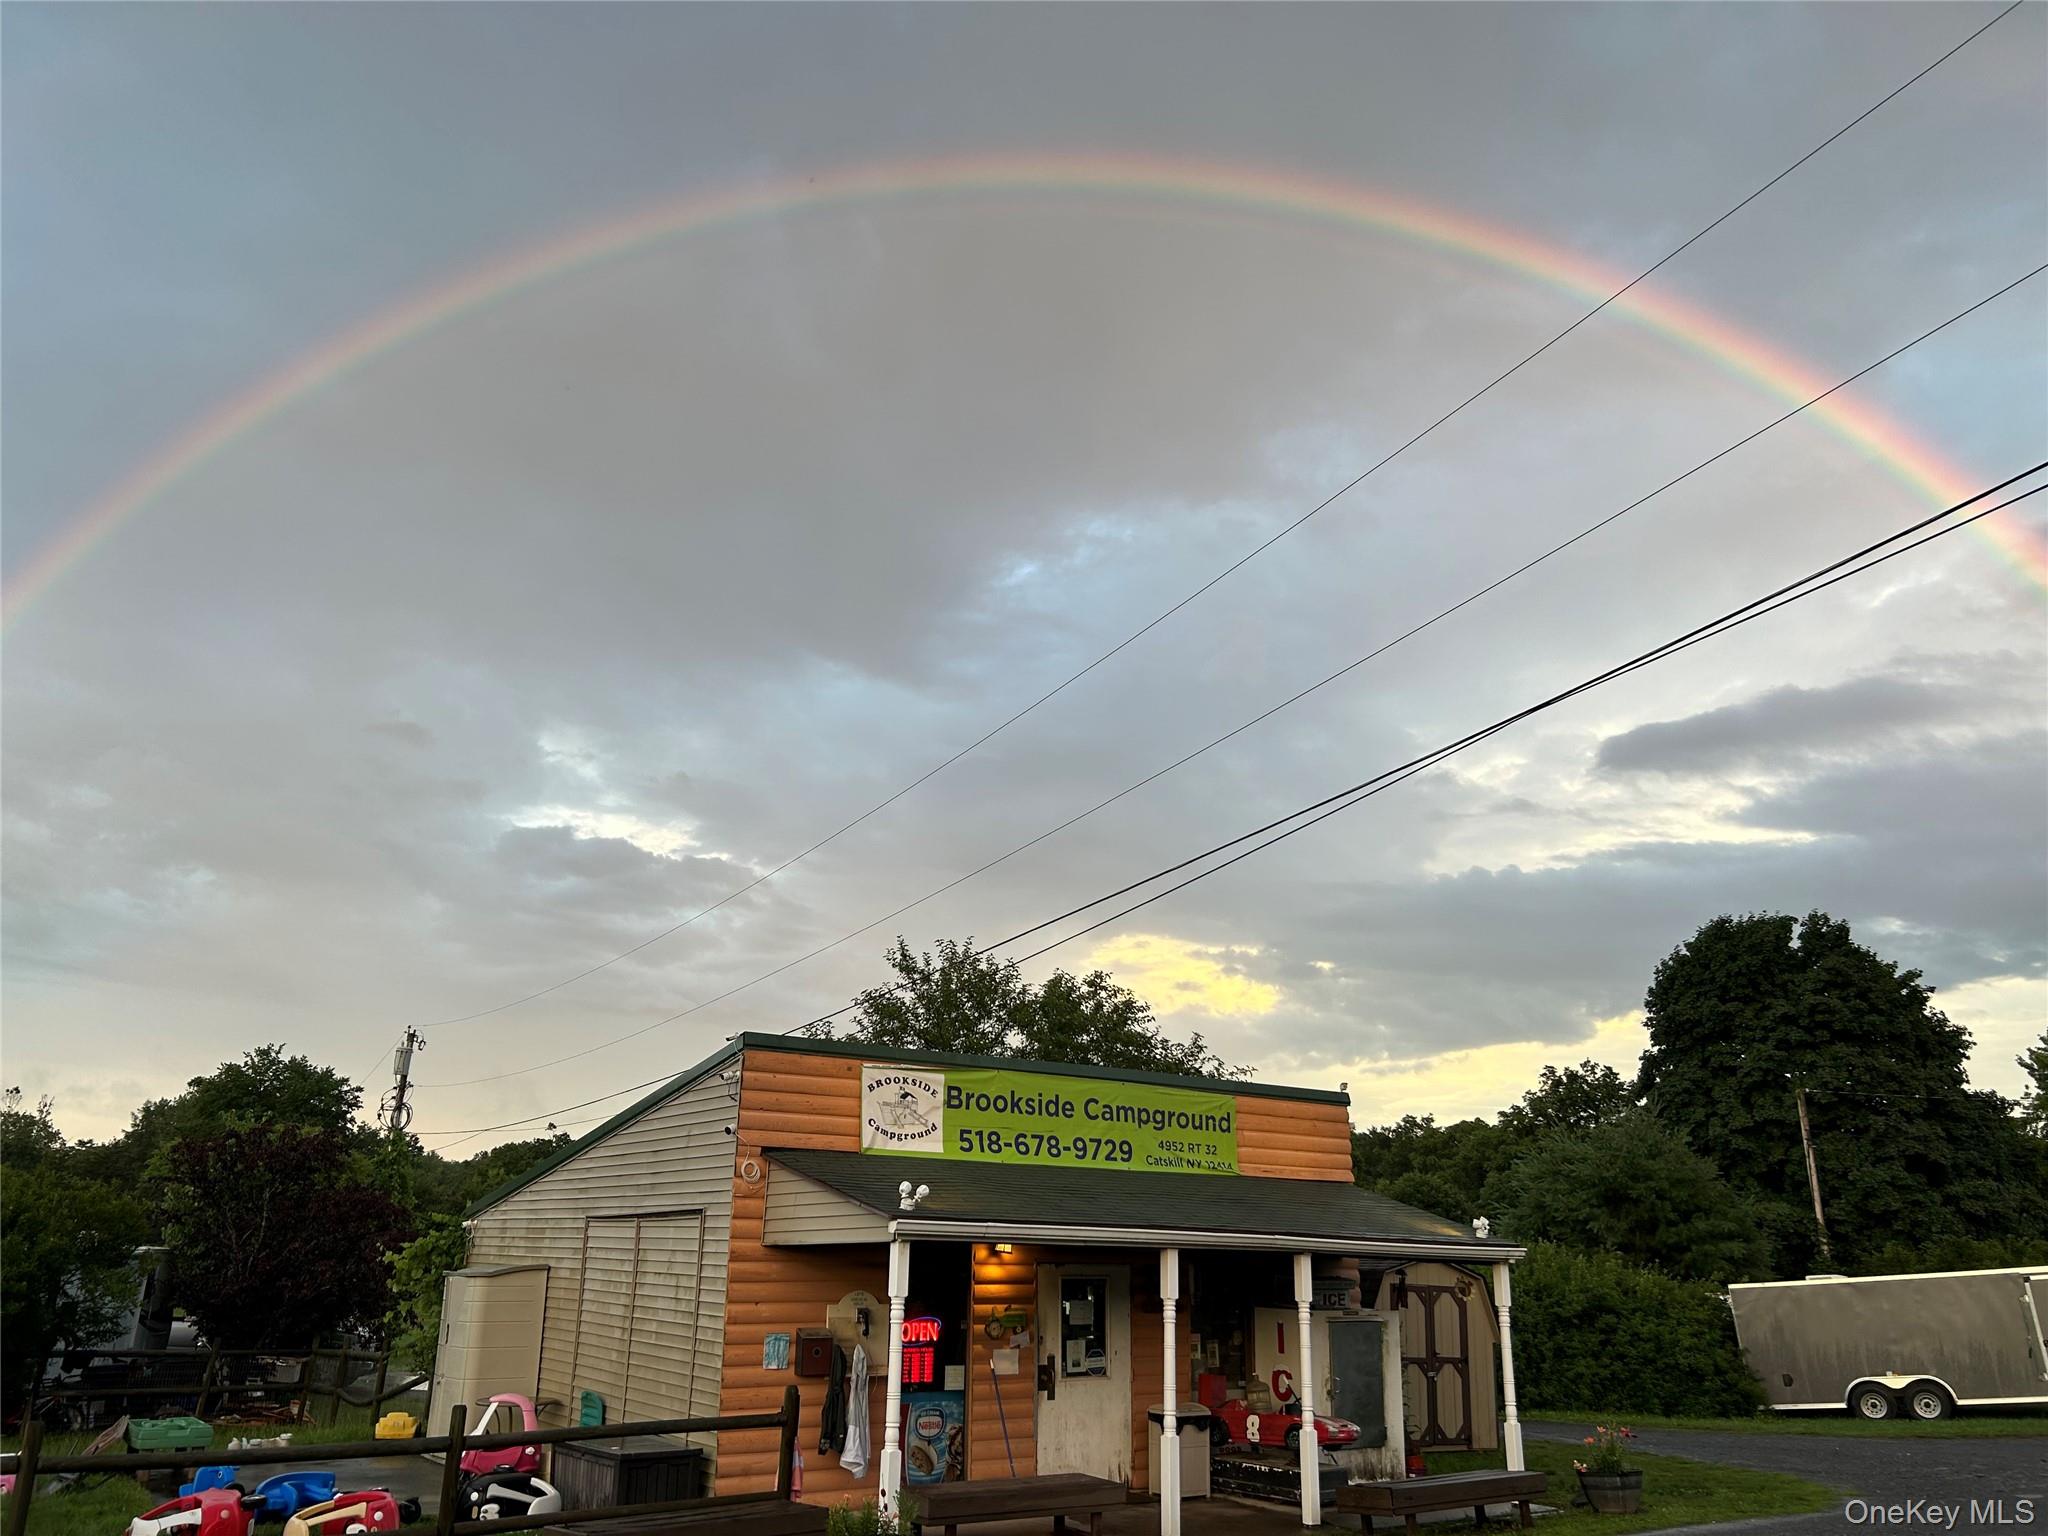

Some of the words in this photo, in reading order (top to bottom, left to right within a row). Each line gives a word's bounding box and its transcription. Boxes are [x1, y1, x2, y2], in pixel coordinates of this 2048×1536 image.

[867, 1076, 939, 1098] BROOKSIDE
[946, 1085, 1075, 1118] Brookside
[1083, 1098, 1232, 1134] Campground
[868, 1118, 938, 1142] Campground
[959, 1128, 1133, 1163] 518-678-9729
[1158, 1140, 1185, 1153] 4952
[1187, 1142, 1202, 1154] RT
[1205, 1144, 1217, 1156] 32
[1145, 1154, 1184, 1169] Catskill
[1186, 1158, 1202, 1169] NY
[1322, 1293, 1346, 1306] ICE
[901, 1322, 938, 1342] OPEN
[1246, 1414, 1261, 1443] 8
